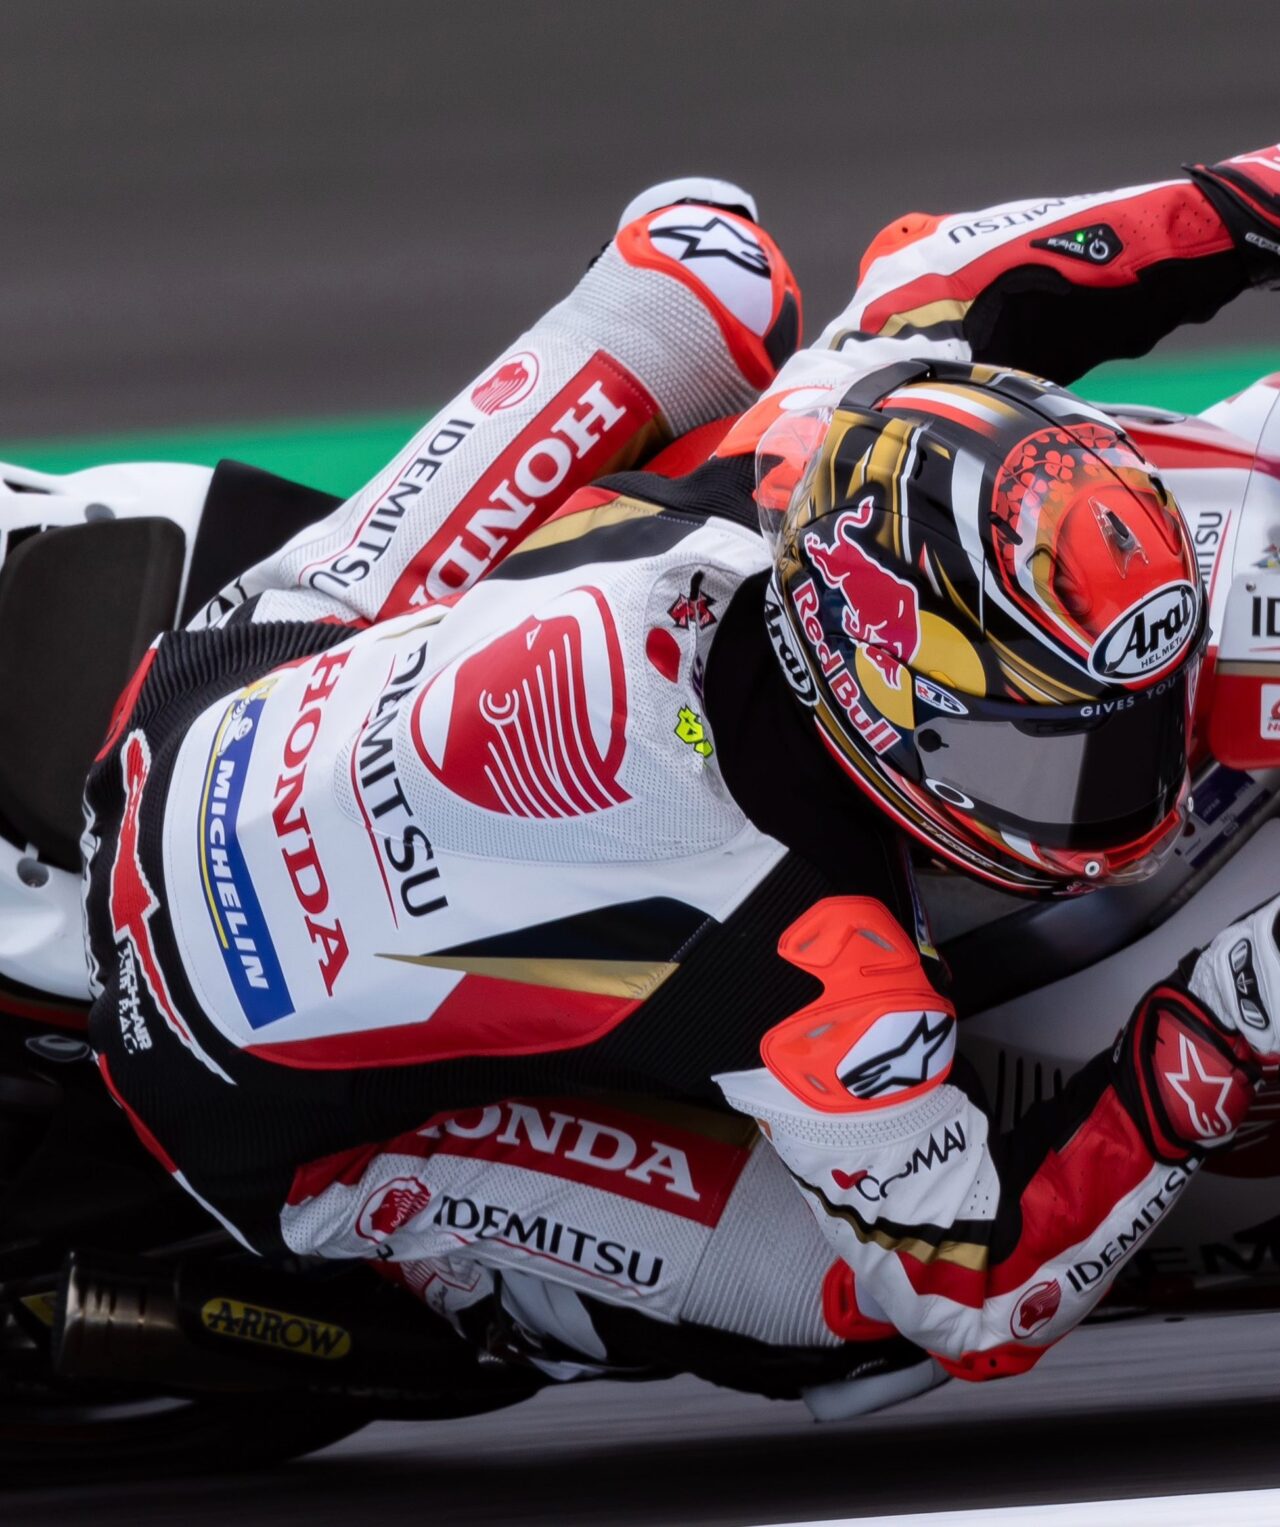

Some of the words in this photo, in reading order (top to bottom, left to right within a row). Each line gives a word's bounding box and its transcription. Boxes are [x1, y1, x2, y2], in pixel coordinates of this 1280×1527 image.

[309, 419, 475, 590] IDEMITSU
[408, 380, 627, 606] HOND
[764, 601, 812, 690] Arai
[792, 578, 845, 677] Red
[828, 668, 902, 756] Bull
[1104, 586, 1191, 673] Arai
[1080, 697, 1135, 717] GIVES
[1146, 677, 1176, 698] YOU
[271, 649, 353, 997] HONDA
[210, 760, 270, 990] MICHELIN
[416, 1102, 701, 1201] ONDA
[433, 1196, 663, 1287] IDEMITSU
[207, 1302, 345, 1355] ARROW
